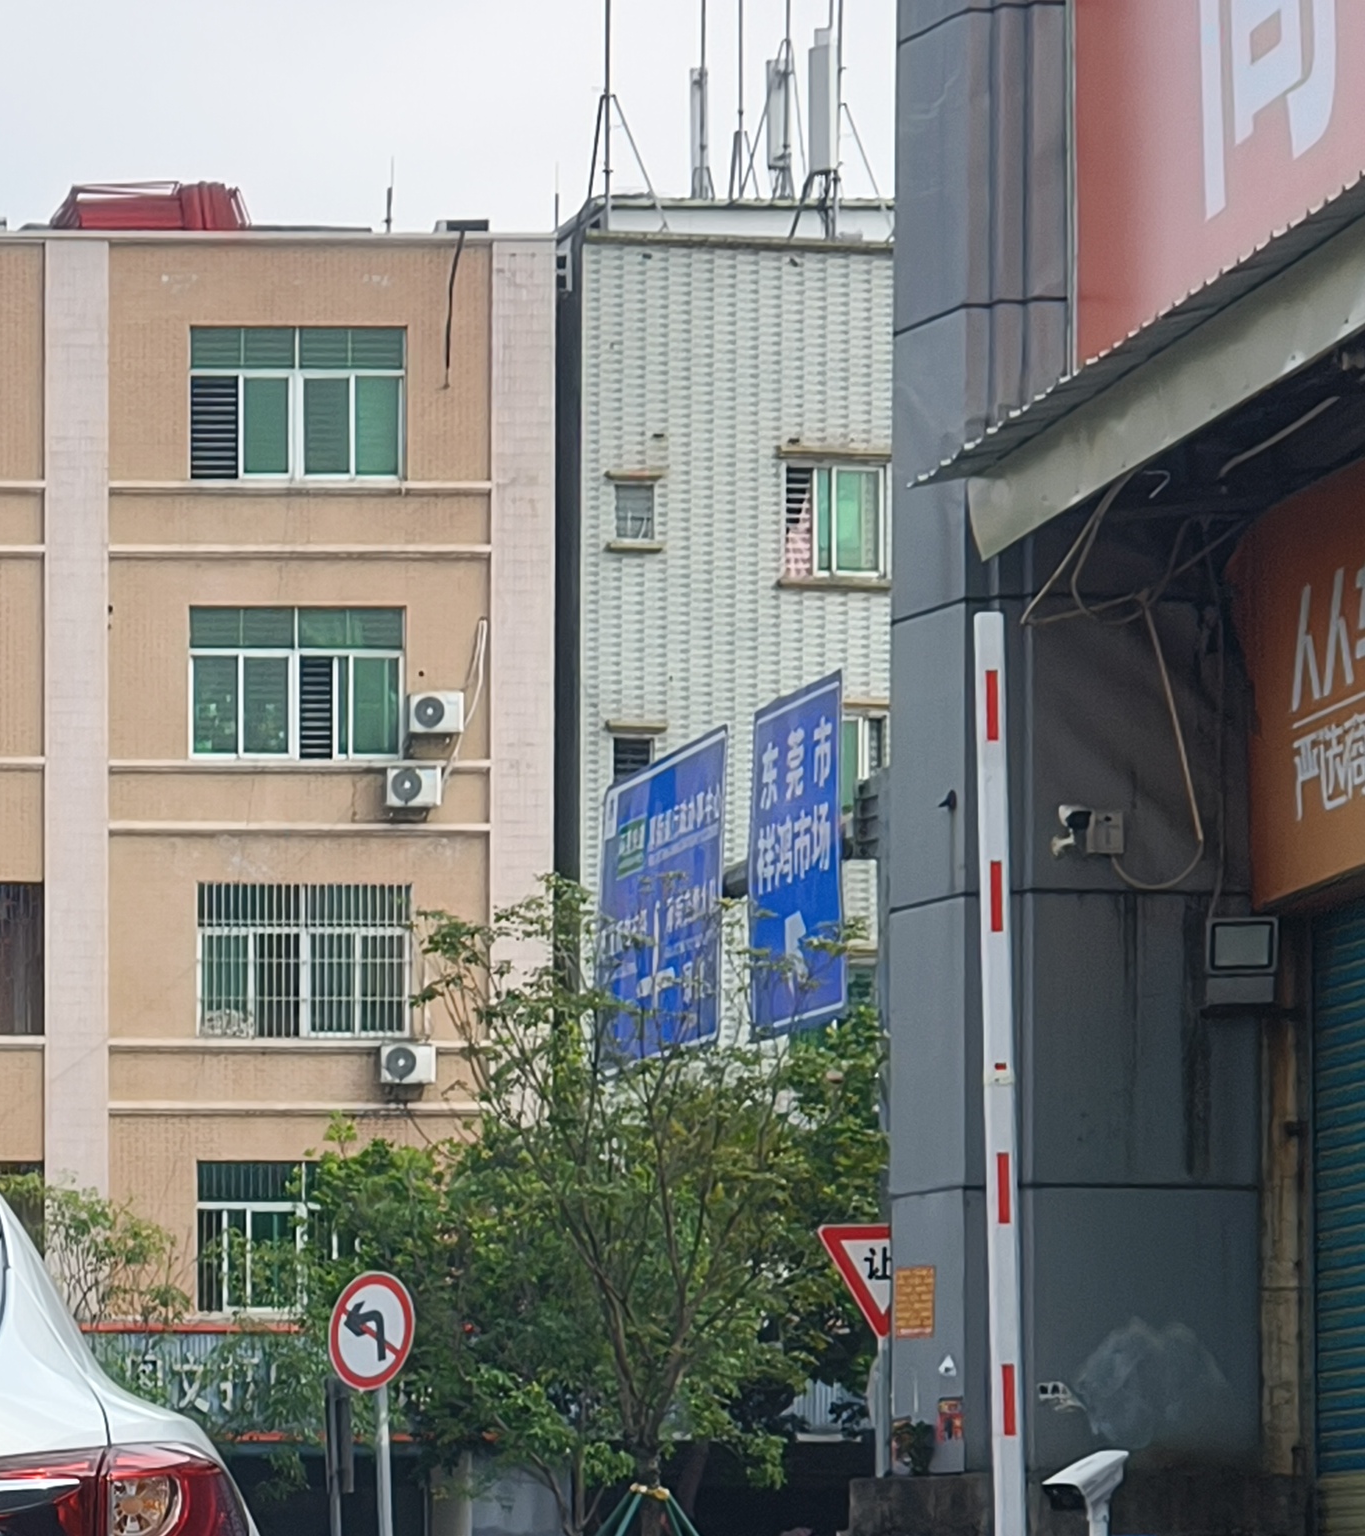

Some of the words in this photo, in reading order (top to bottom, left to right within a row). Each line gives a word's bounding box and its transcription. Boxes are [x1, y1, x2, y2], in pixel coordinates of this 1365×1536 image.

[759, 714, 833, 809] 东莞市
[756, 801, 831, 895] 祥鸿市场
